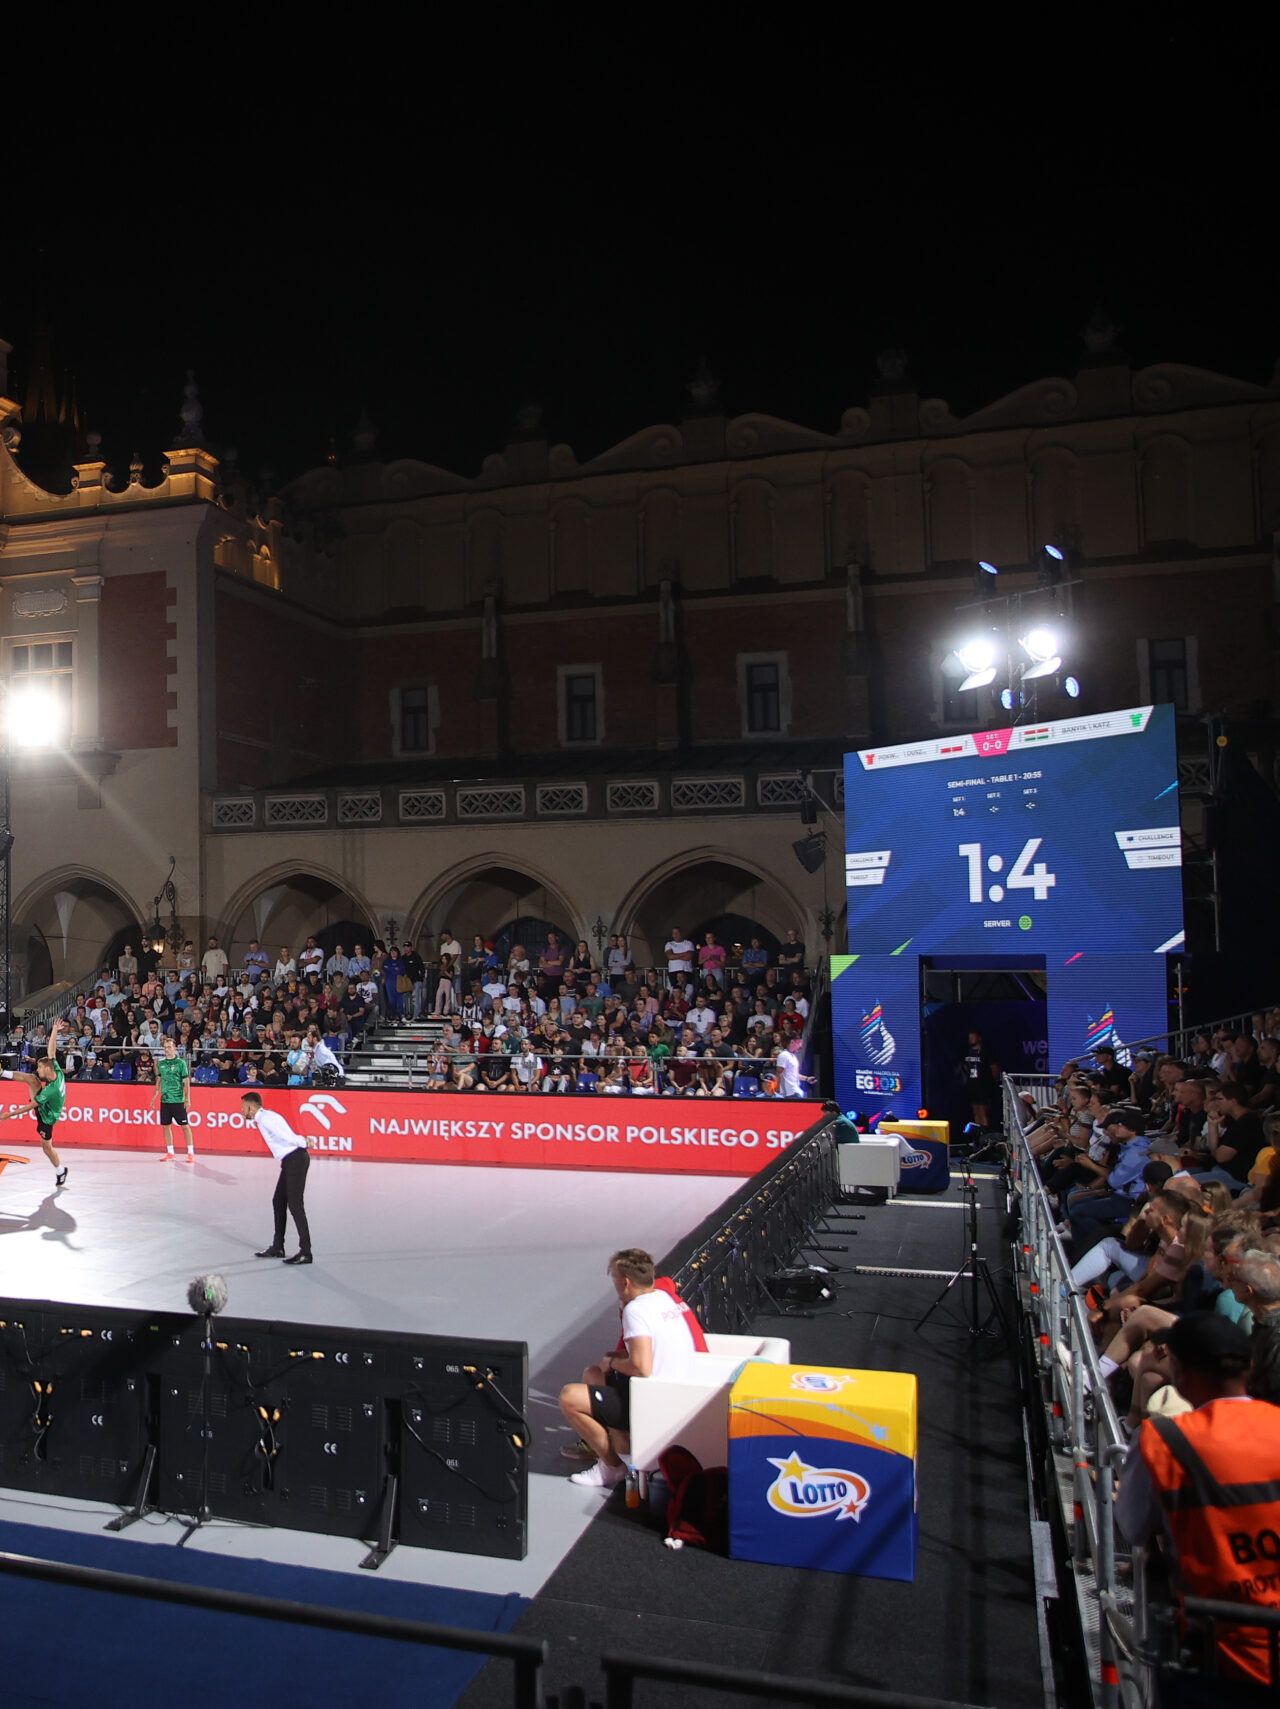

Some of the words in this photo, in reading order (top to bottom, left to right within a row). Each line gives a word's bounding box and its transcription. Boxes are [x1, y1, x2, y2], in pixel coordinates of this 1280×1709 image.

[985, 733, 999, 741] SET
[982, 740, 1002, 752] 0-0
[947, 778, 986, 789] SEMI-FINAL
[990, 774, 1013, 784] TABLE
[953, 808, 965, 817] 1:4
[1138, 833, 1174, 841] CHALLENGE
[1147, 853, 1174, 861] TIMEOUT
[958, 837, 1056, 903] 1:4
[983, 919, 1012, 928] SERVER
[369, 1118, 505, 1141] NAJWIĘKSZY
[510, 1122, 619, 1143] SPONSOR
[626, 1126, 759, 1148] POLSKIEGO
[306, 1135, 353, 1152] RLEN
[902, 1154, 924, 1164] LOTTO
[789, 1481, 848, 1504] LOTTO
